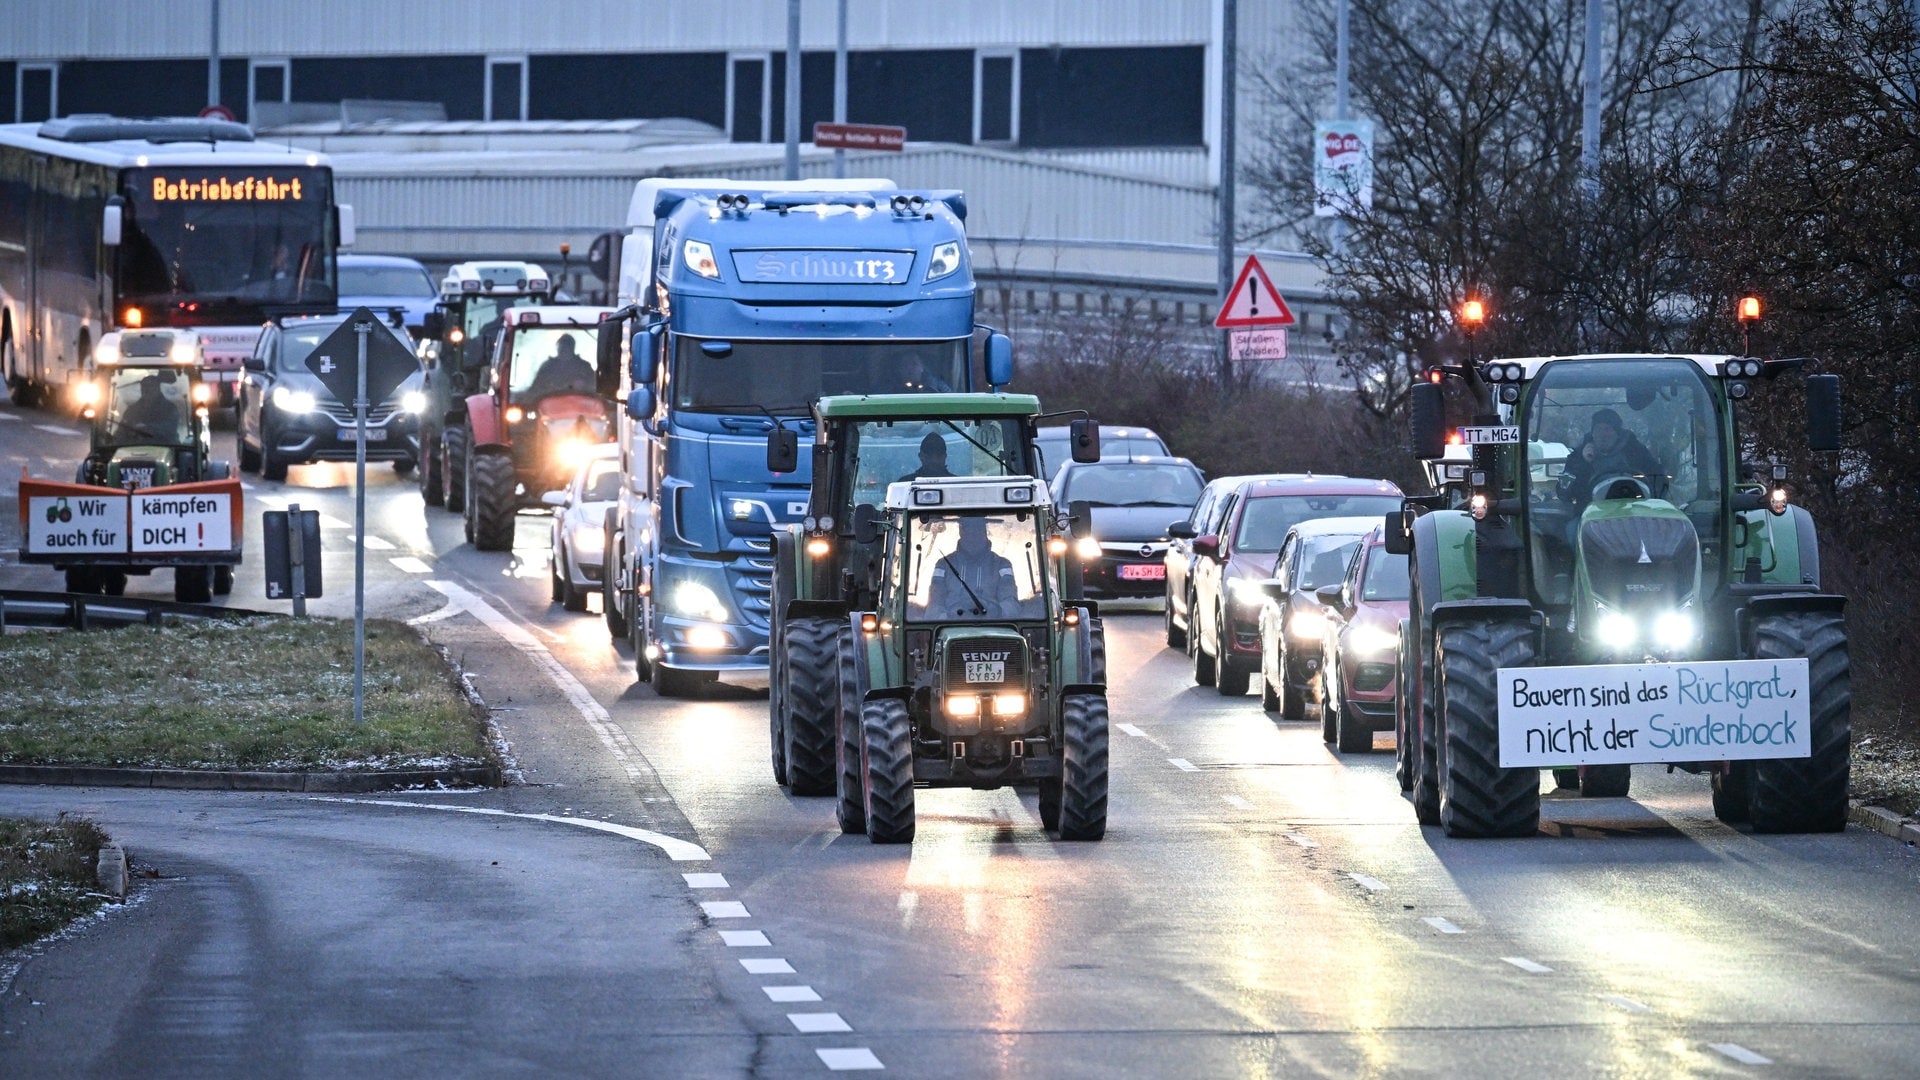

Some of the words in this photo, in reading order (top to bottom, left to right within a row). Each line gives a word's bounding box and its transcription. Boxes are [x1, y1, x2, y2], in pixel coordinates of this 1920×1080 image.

[153, 176, 302, 200] Betriebsfahrt
[755, 252, 896, 280] Schwarz
[1466, 429, 1482, 442] TT
[79, 500, 107, 516] Wir
[142, 497, 217, 518] kämpfen
[46, 530, 87, 547] auch
[92, 529, 116, 546] für
[143, 527, 186, 545] DICH
[1124, 566, 1135, 576] RV
[961, 651, 1011, 662] FENDT
[968, 672, 982, 681] CY
[977, 663, 992, 672] FN
[1513, 678, 1586, 708] Bauern
[1590, 681, 1631, 707] sind
[1637, 680, 1668, 702] das
[1676, 665, 1797, 709] Rückgrat,
[1527, 719, 1599, 754] nicht
[1603, 718, 1640, 750] der
[1649, 710, 1797, 749] Sündenbock
